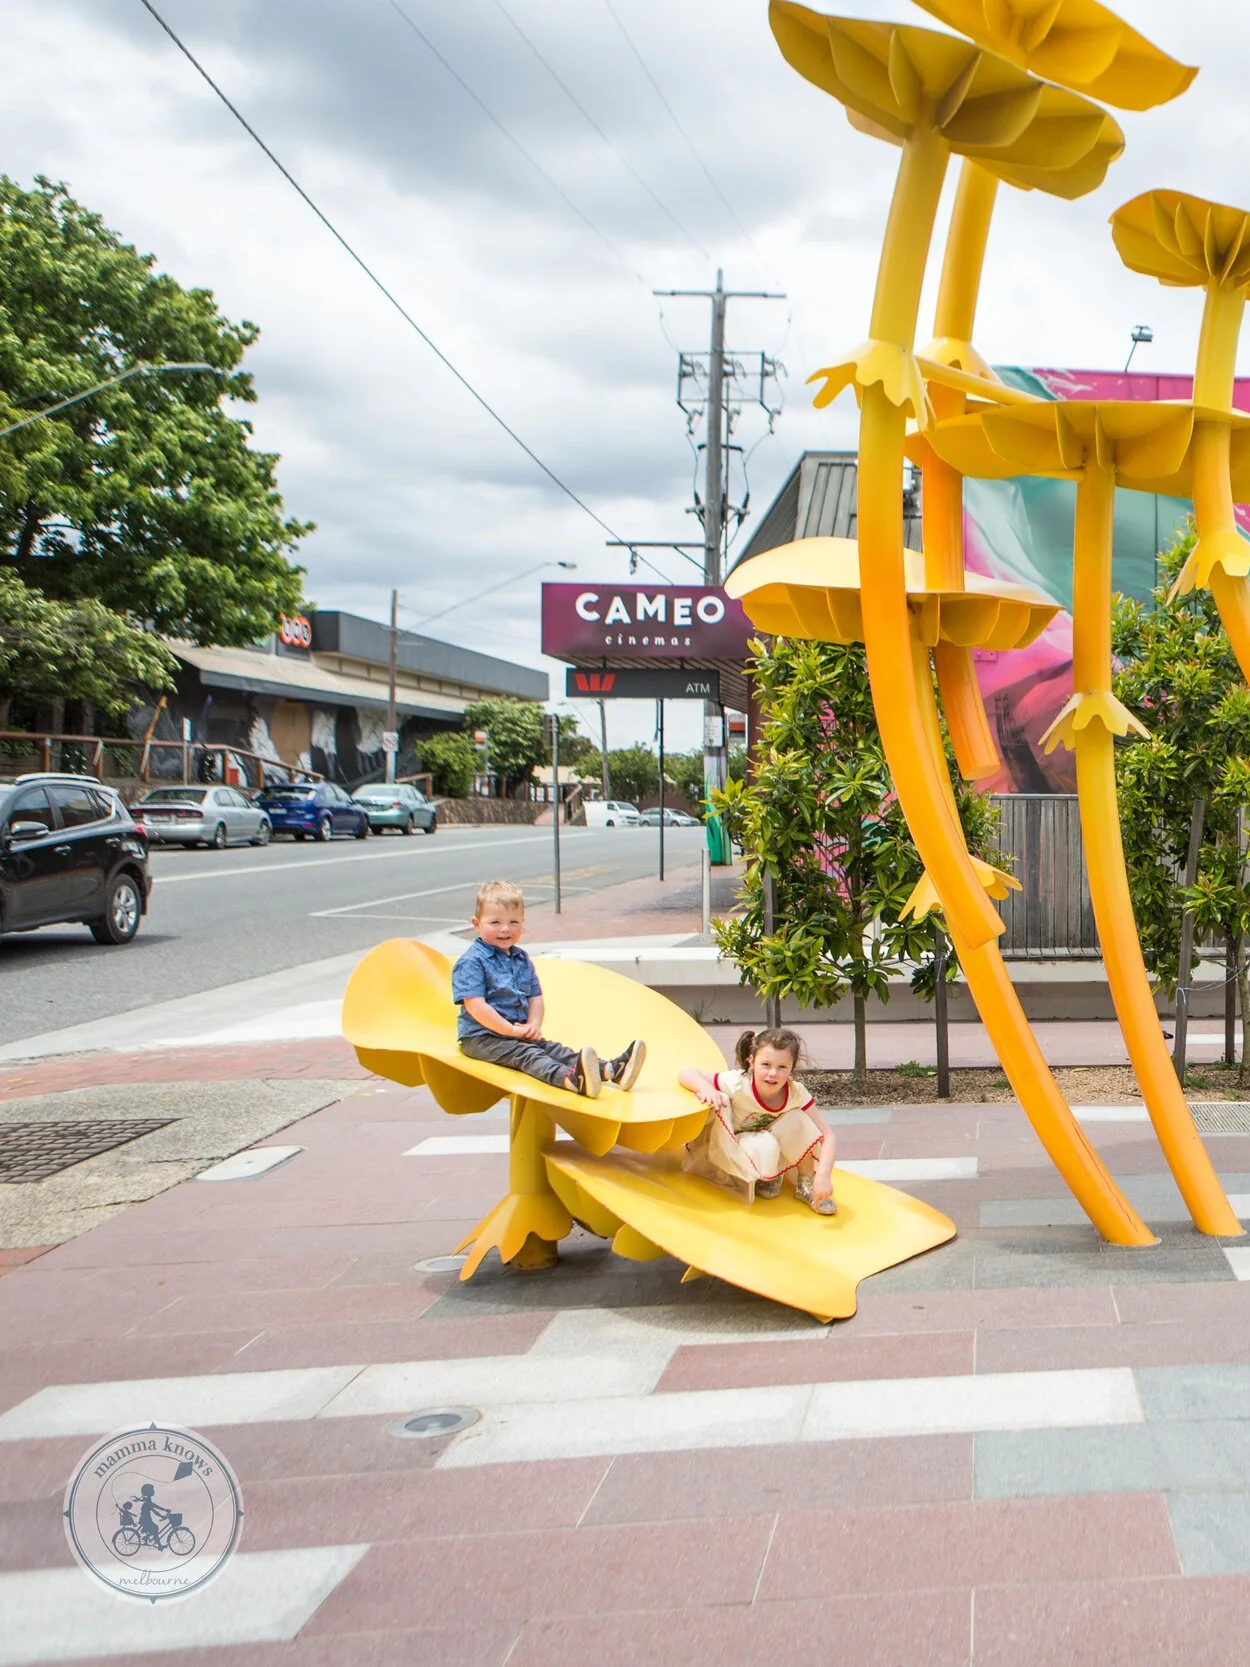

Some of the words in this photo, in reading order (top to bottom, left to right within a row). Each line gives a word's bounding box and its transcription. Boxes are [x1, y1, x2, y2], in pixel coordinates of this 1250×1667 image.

[575, 592, 725, 626] CAMEO
[605, 633, 691, 646] cinemas
[686, 683, 710, 694] ATM
